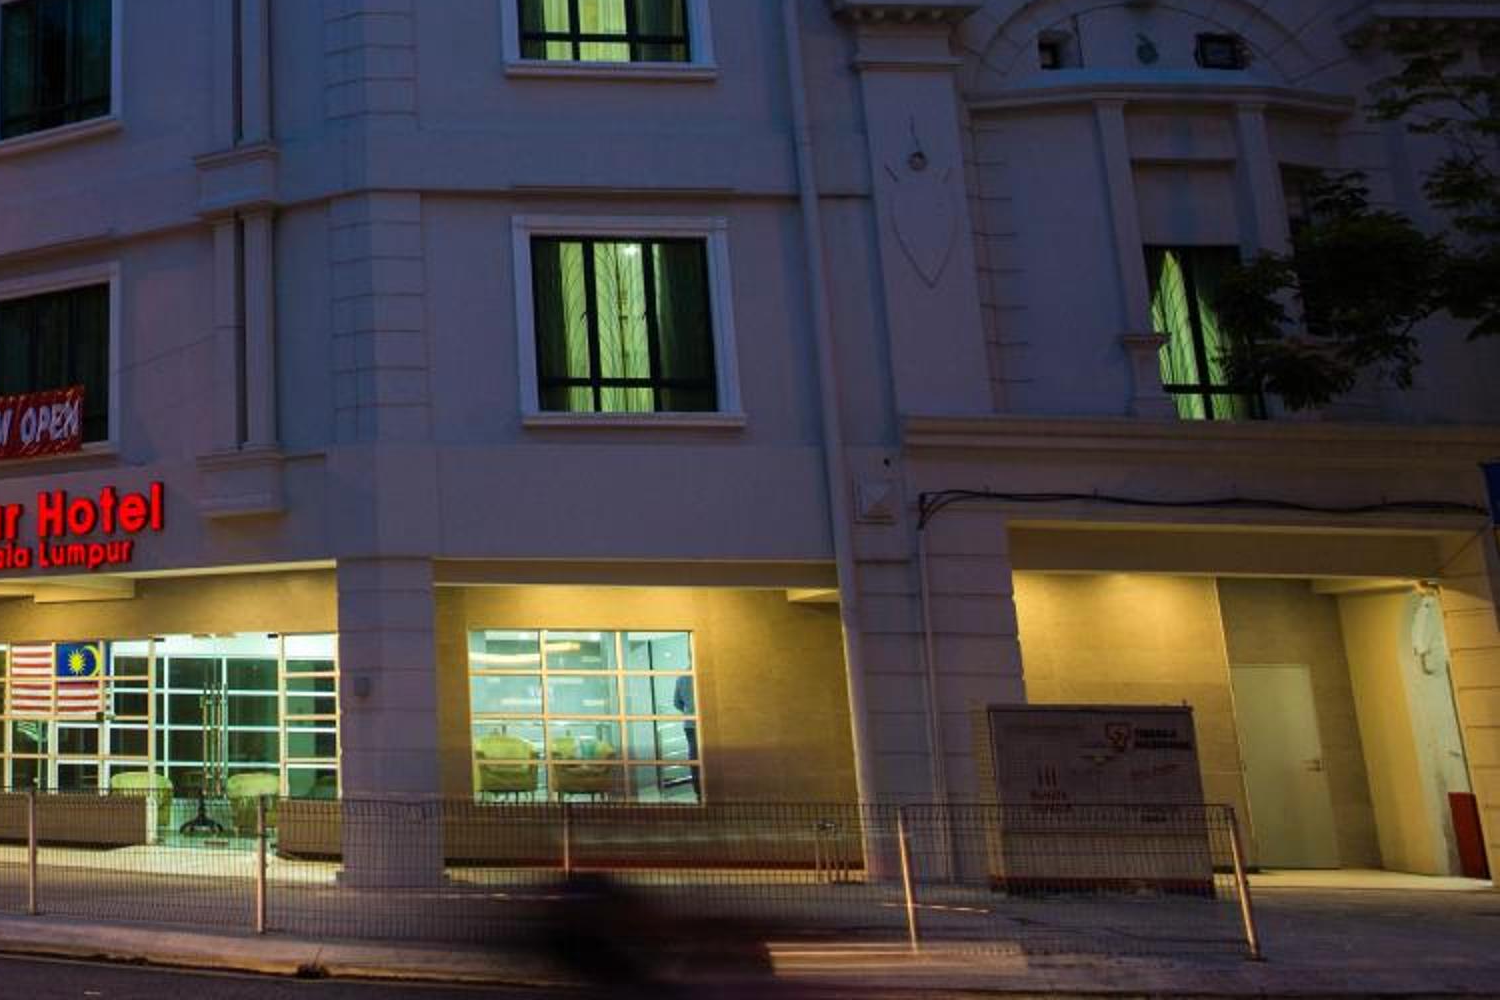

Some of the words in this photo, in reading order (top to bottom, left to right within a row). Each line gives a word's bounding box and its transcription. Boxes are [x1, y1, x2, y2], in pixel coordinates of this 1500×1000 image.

[19, 400, 80, 444] OPEN
[36, 481, 164, 538] Hotel
[38, 539, 132, 569] Lumpur
